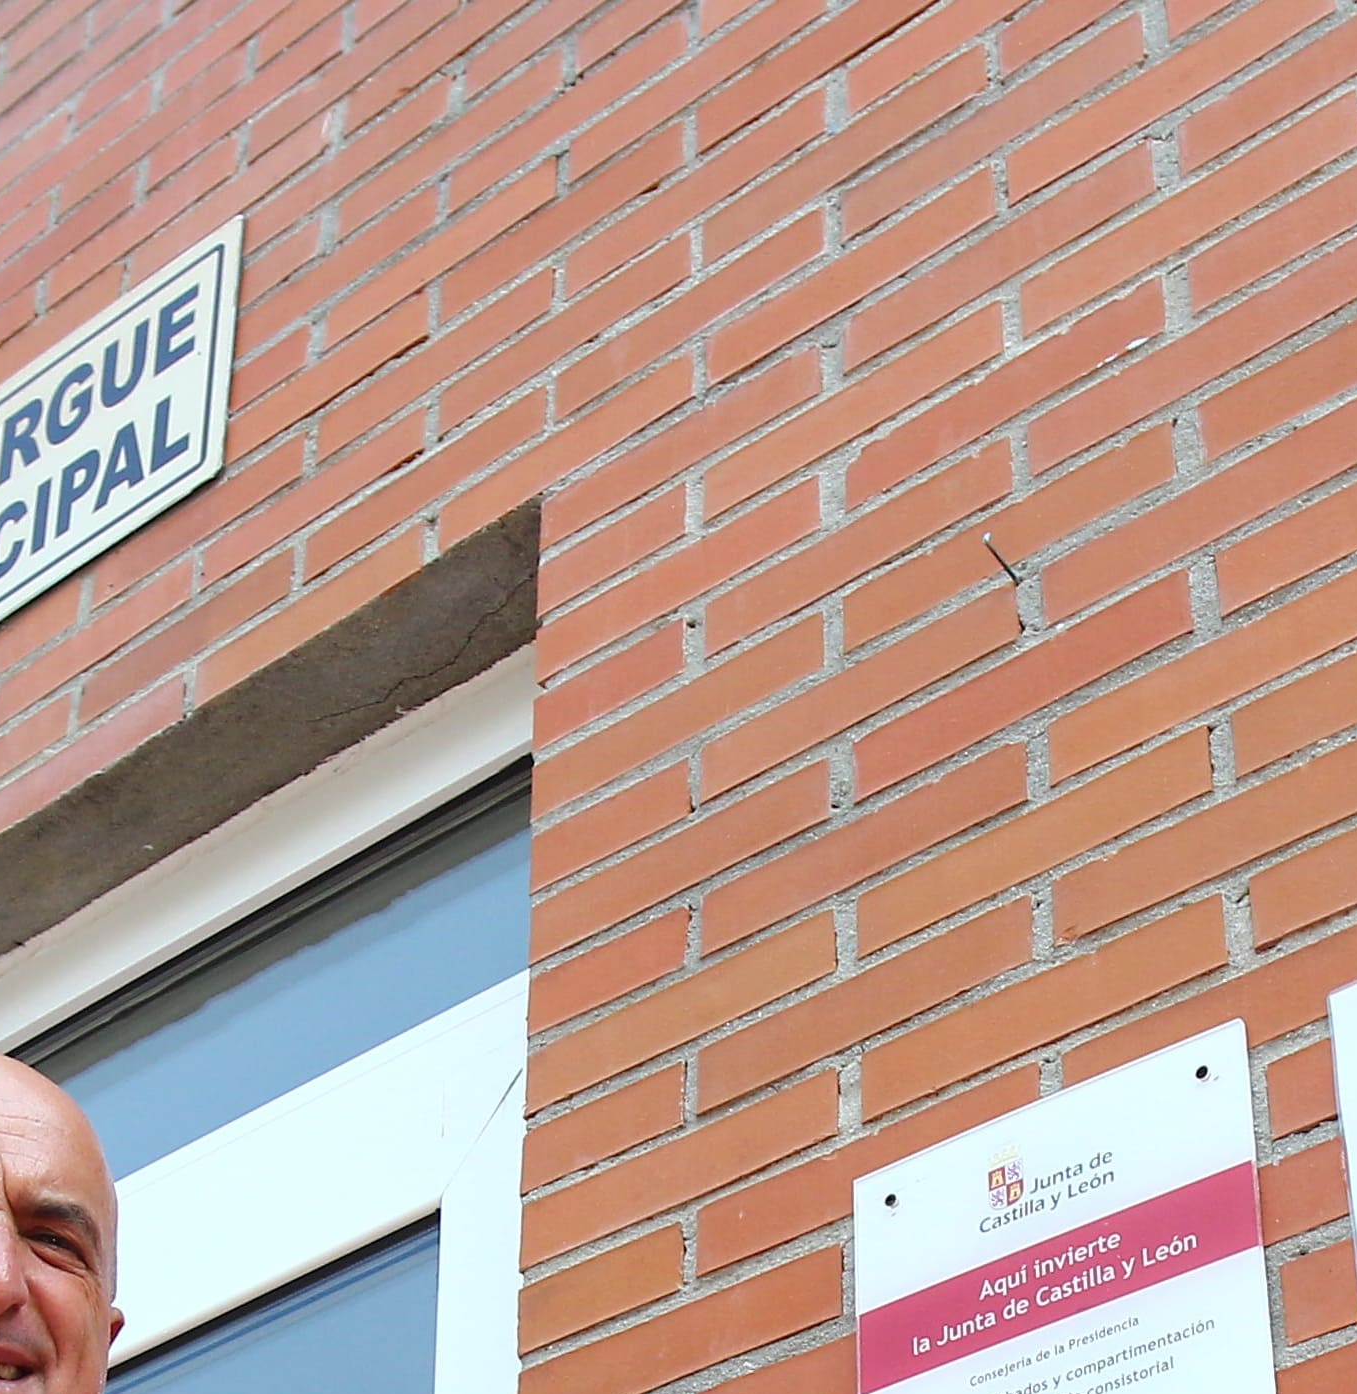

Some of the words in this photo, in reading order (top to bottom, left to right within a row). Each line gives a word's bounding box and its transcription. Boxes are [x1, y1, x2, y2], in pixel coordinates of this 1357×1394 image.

[979, 1198, 1045, 1233] Castilla
[1050, 1191, 1061, 1211] y
[1067, 1170, 1114, 1199] León
[1029, 1163, 1083, 1194] Junta
[1089, 1151, 1113, 1169] de
[913, 1337, 930, 1355] la
[936, 1312, 996, 1346] Junta
[1003, 1298, 1029, 1319] de
[1035, 1265, 1115, 1306] Castilla
[1121, 1257, 1135, 1279] y
[1142, 1234, 1197, 1266] León
[979, 1264, 1027, 1300] Aquí
[1033, 1233, 1120, 1278] invierte
[1035, 1349, 1051, 1362] de
[1054, 1344, 1065, 1356] la
[1068, 1317, 1139, 1350] Presidencia
[1052, 1374, 1061, 1390] y
[1065, 1319, 1215, 1382] compartimentación
